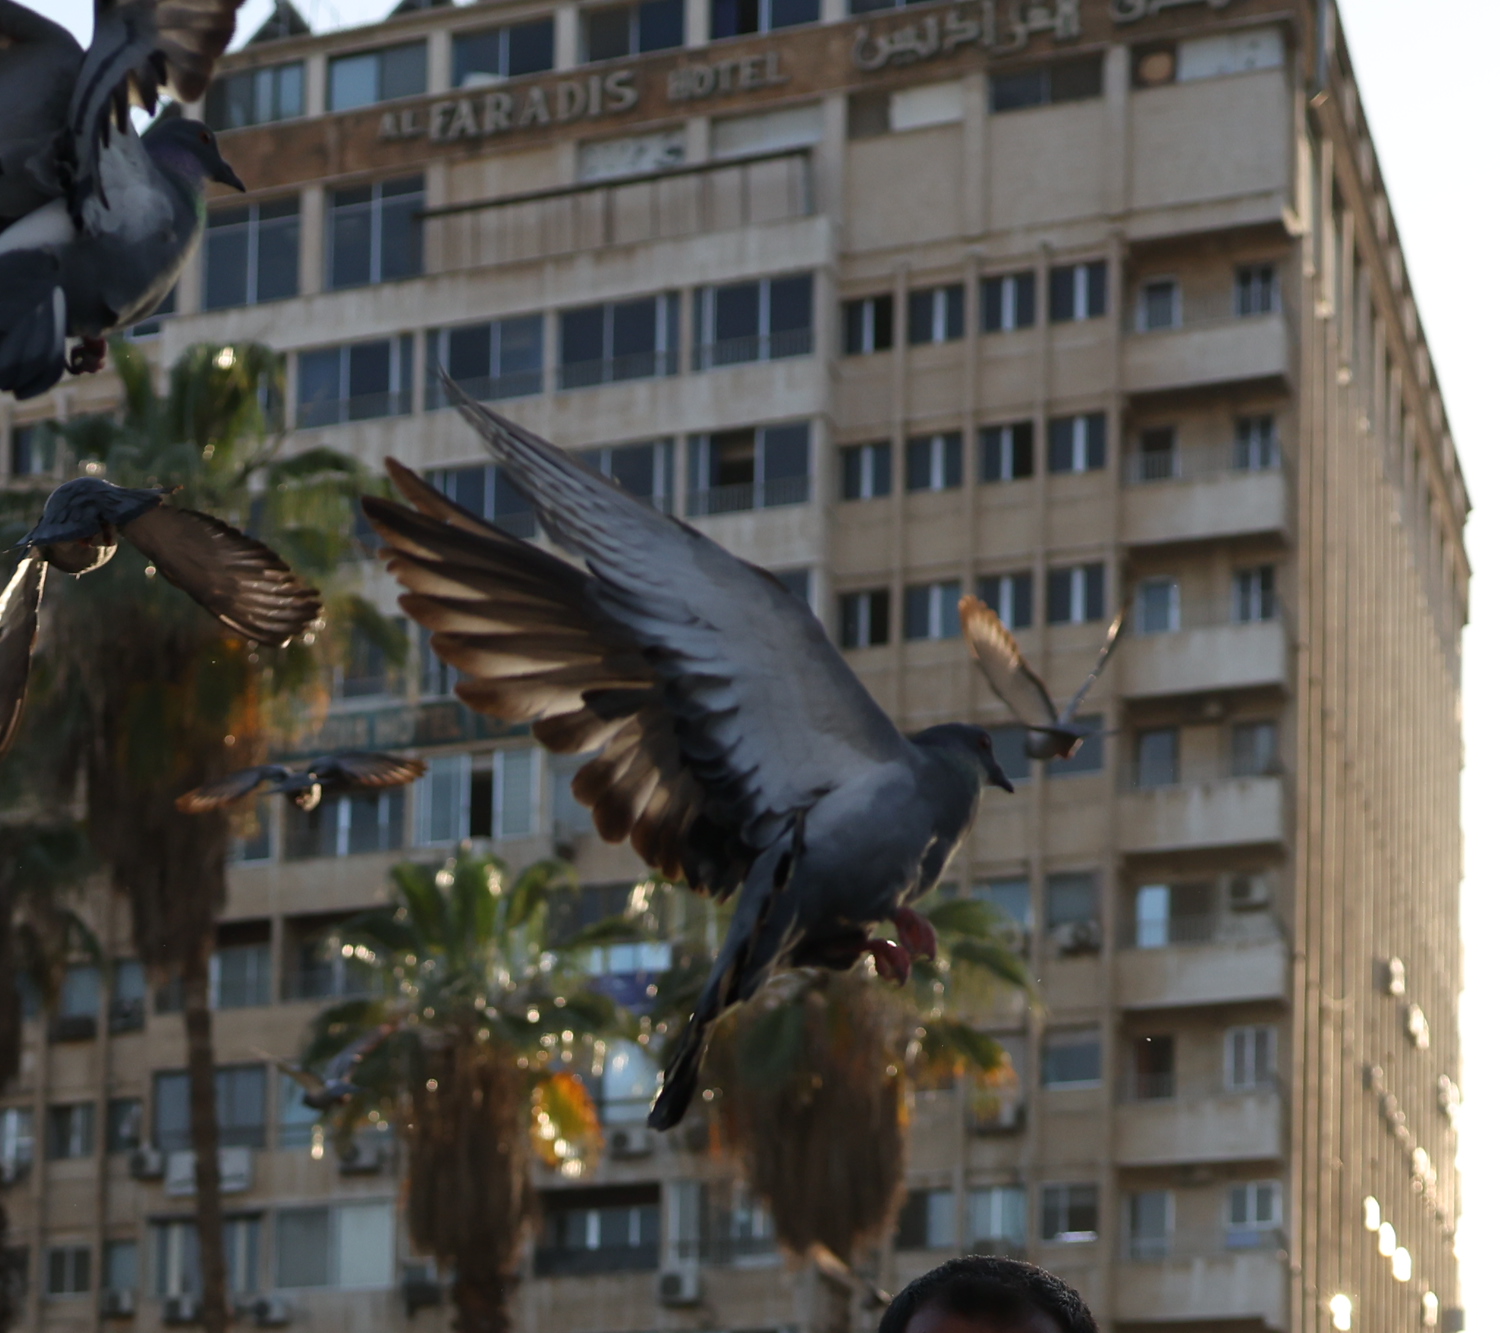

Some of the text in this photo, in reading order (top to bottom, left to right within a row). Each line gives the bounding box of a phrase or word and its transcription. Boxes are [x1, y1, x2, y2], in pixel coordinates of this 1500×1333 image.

[377, 51, 791, 142] AL FARADIS HOTEL
